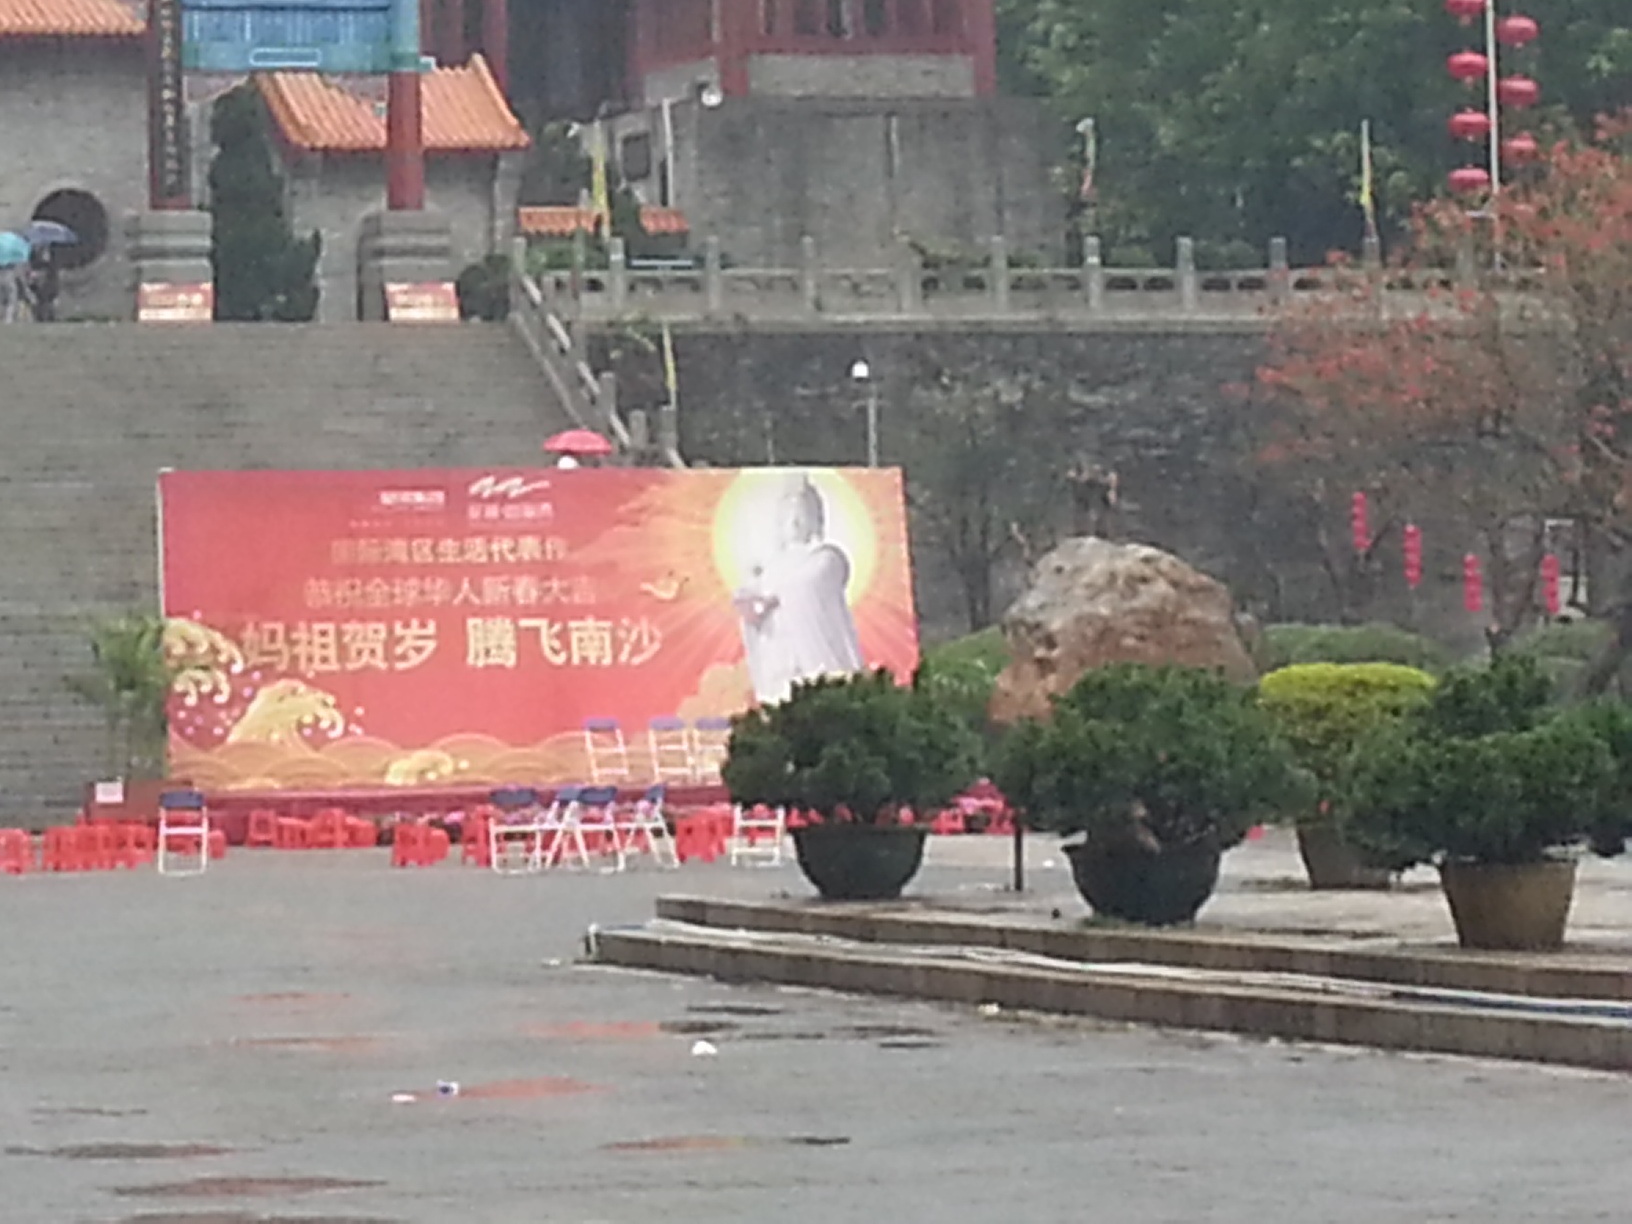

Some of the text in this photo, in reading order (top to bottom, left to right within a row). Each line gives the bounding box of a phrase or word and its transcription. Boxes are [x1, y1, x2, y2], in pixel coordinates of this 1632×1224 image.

[240, 616, 664, 672] 妈祖贺岁 腾飞南沙
